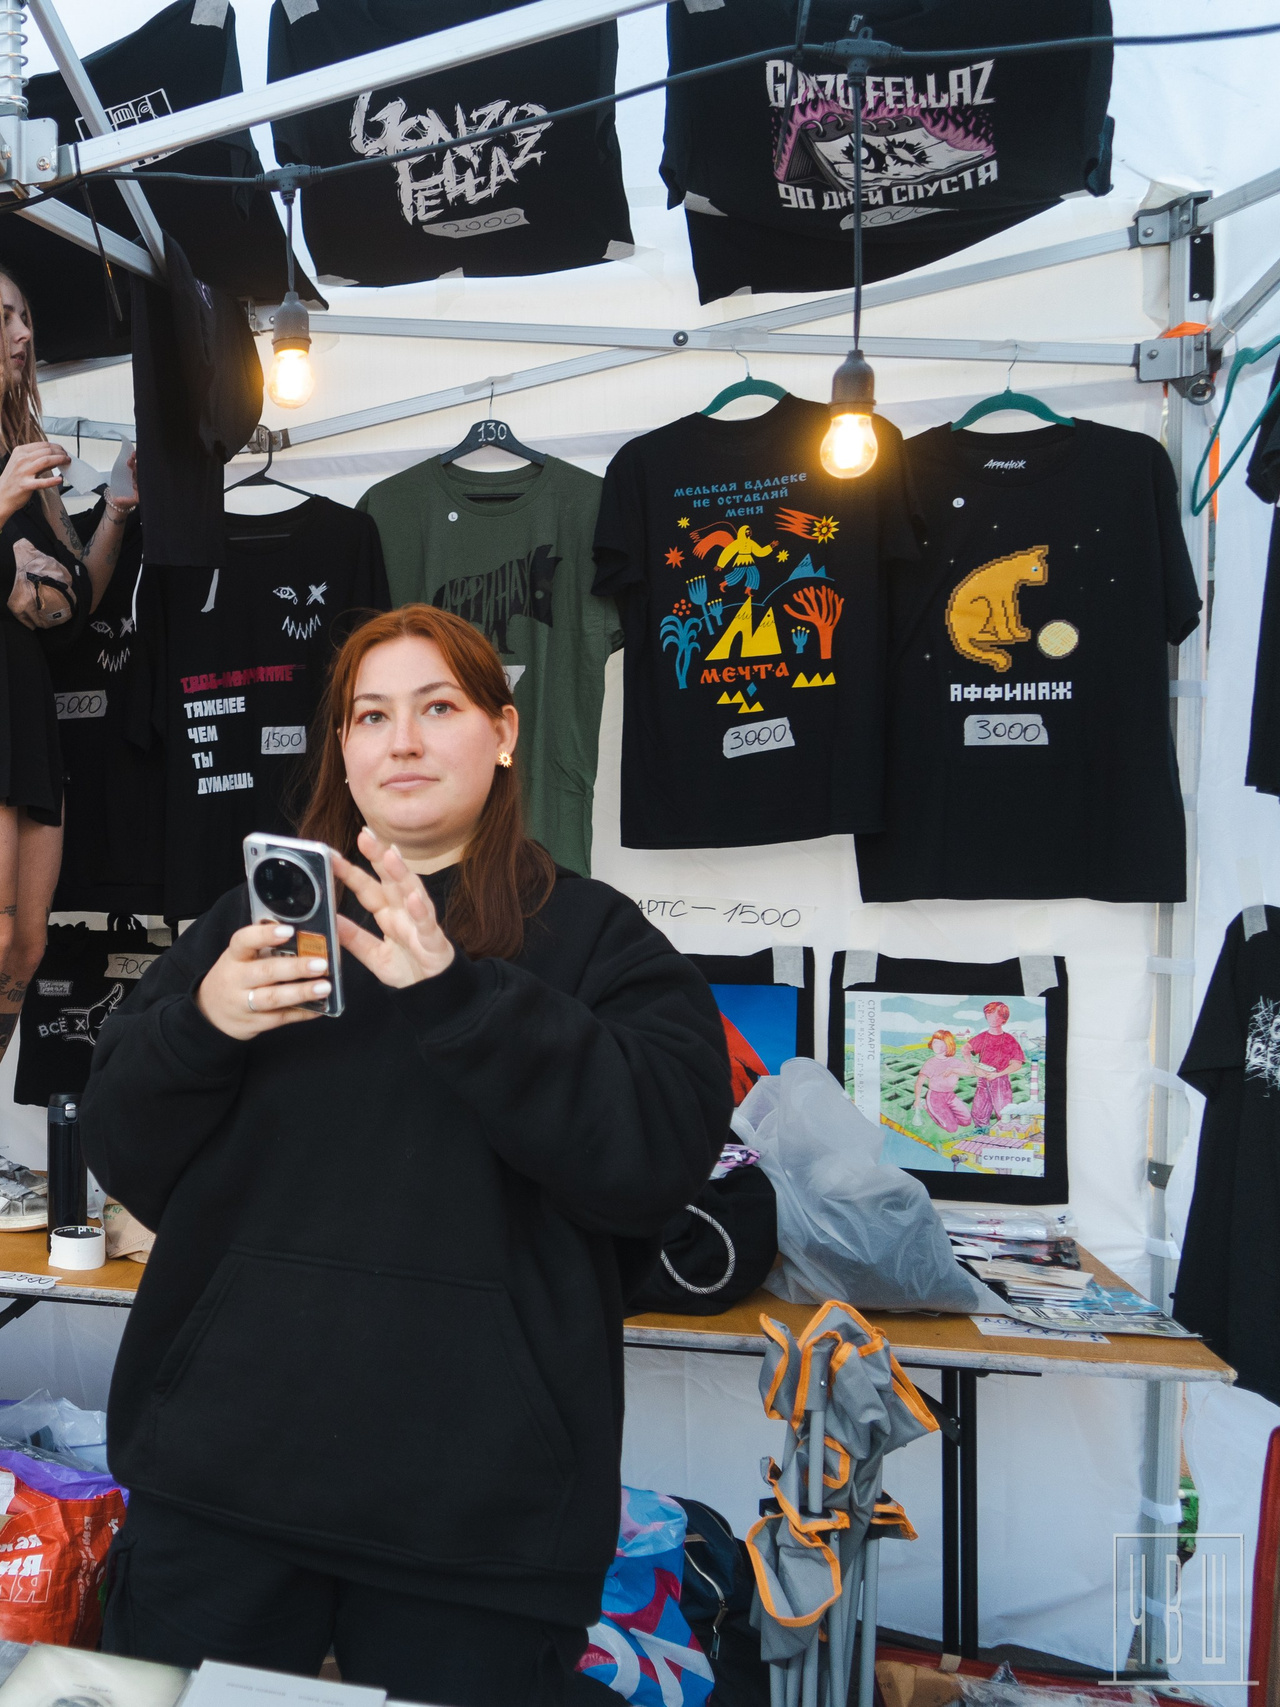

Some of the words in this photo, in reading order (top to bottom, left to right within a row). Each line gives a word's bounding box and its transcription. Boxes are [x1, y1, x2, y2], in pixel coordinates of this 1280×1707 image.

[865, 59, 996, 110] FELLAZ
[778, 183, 816, 210] 90
[891, 160, 999, 204] СПУСТЯ
[442, 212, 521, 233] 2000
[477, 422, 508, 442] 130
[673, 482, 737, 498] МЕЛЬКАЯ
[744, 472, 807, 491] ВДАЛЕКЕ
[693, 498, 710, 508] НЕ
[717, 486, 789, 506] ОСТАВЛЯЙ
[725, 505, 764, 518] МЕНЯ
[950, 681, 1072, 702] АФФИНАЖ
[184, 696, 246, 719] ТЯЖЕЛЕЕ
[187, 725, 218, 744] ЧЕМ
[263, 731, 302, 750] 1500
[730, 724, 787, 750] 3000
[976, 719, 1041, 742] 3000
[192, 751, 213, 769] ТЫ
[197, 772, 254, 795] ДУМАЕШЬ
[723, 903, 801, 928] 1500
[38, 1018, 68, 1037] ВСЁ
[867, 999, 875, 1061] СТОРМХАРТС
[983, 1154, 1032, 1163] СУПЕРГОРЕ
